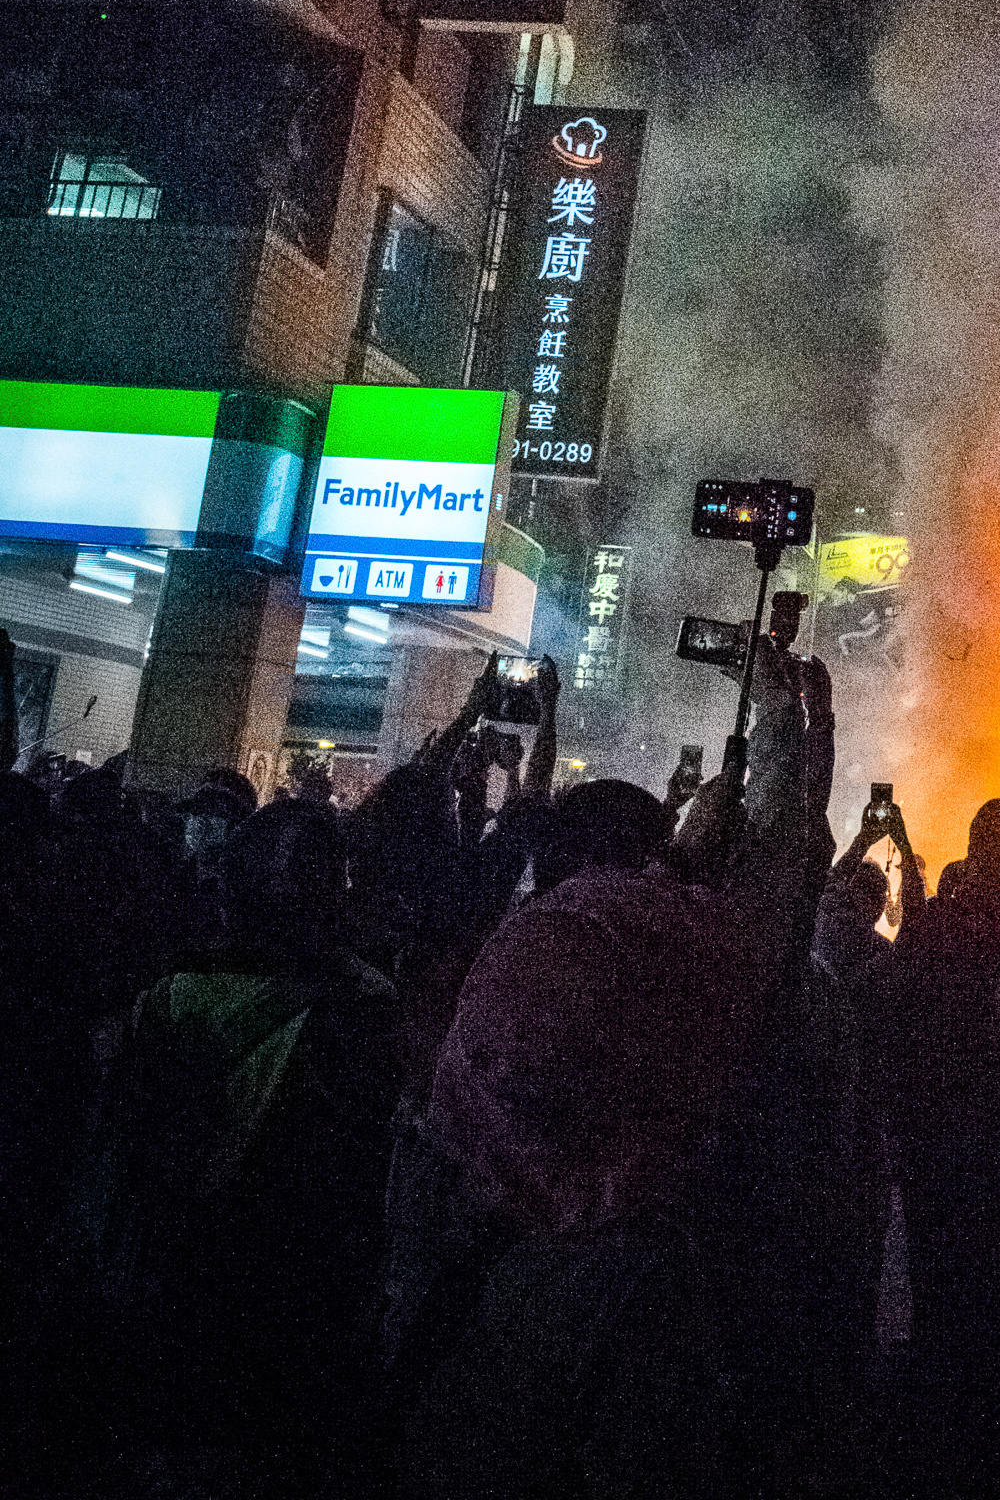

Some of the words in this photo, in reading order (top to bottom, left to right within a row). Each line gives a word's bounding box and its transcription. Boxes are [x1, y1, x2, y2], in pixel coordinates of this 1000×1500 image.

[539, 177, 597, 282] 樂廚
[526, 293, 573, 430] 烹飪教室
[322, 478, 484, 517] FamilyMart
[375, 569, 405, 588] ATM
